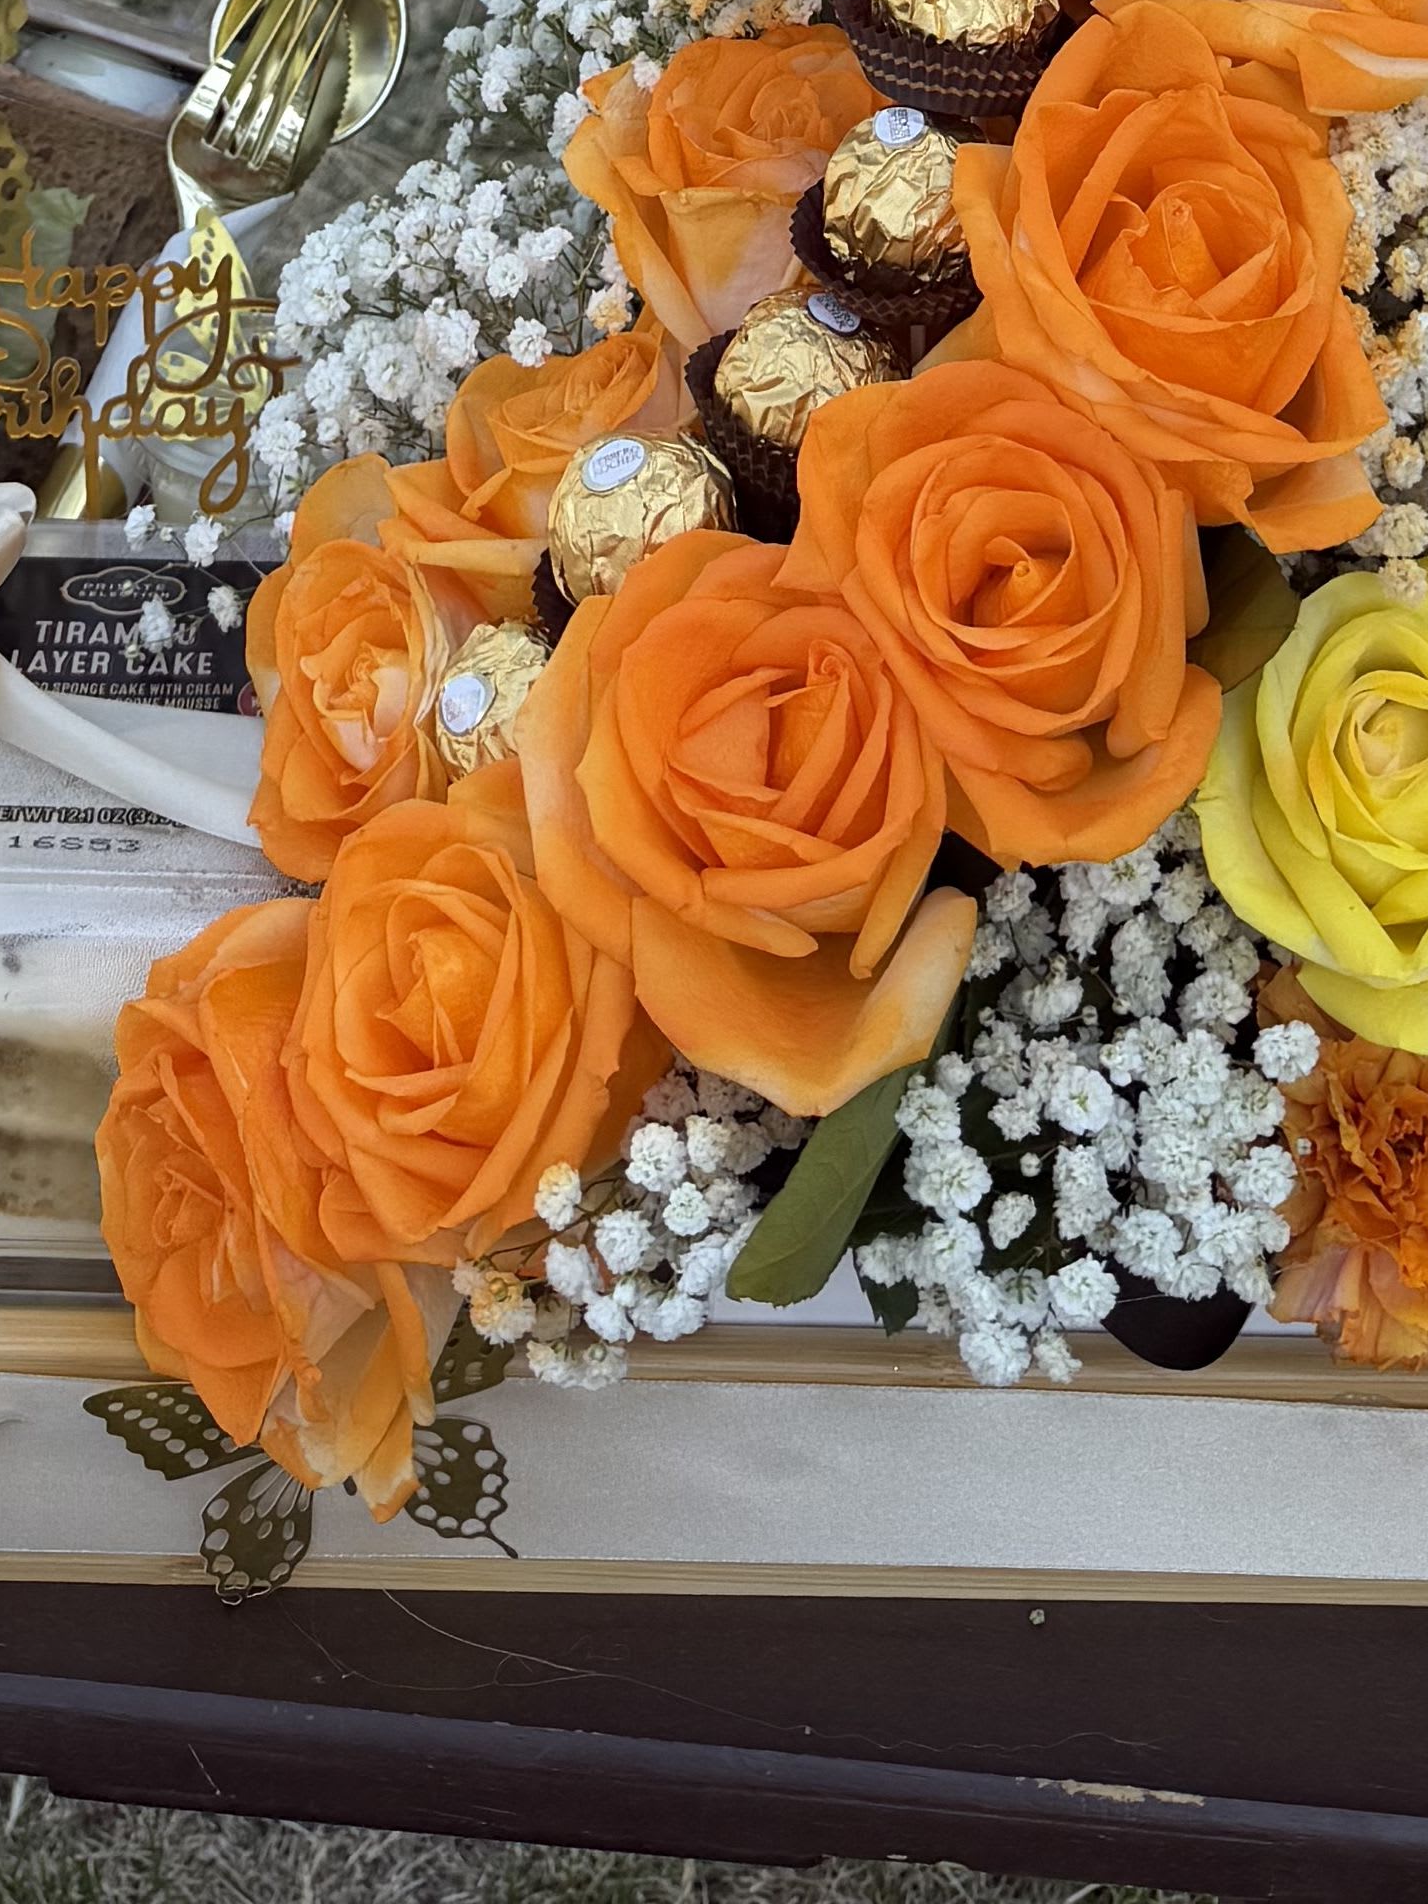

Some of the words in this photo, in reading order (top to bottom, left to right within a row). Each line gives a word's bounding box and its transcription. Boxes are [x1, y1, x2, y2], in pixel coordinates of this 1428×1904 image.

[35, 620, 198, 646] TIRAMU
[125, 652, 214, 676] CAKE
[109, 682, 147, 695] CAKE
[149, 682, 182, 696] WITH
[186, 683, 234, 696] CREAM
[21, 806, 55, 822] WT
[97, 808, 126, 824] OZ
